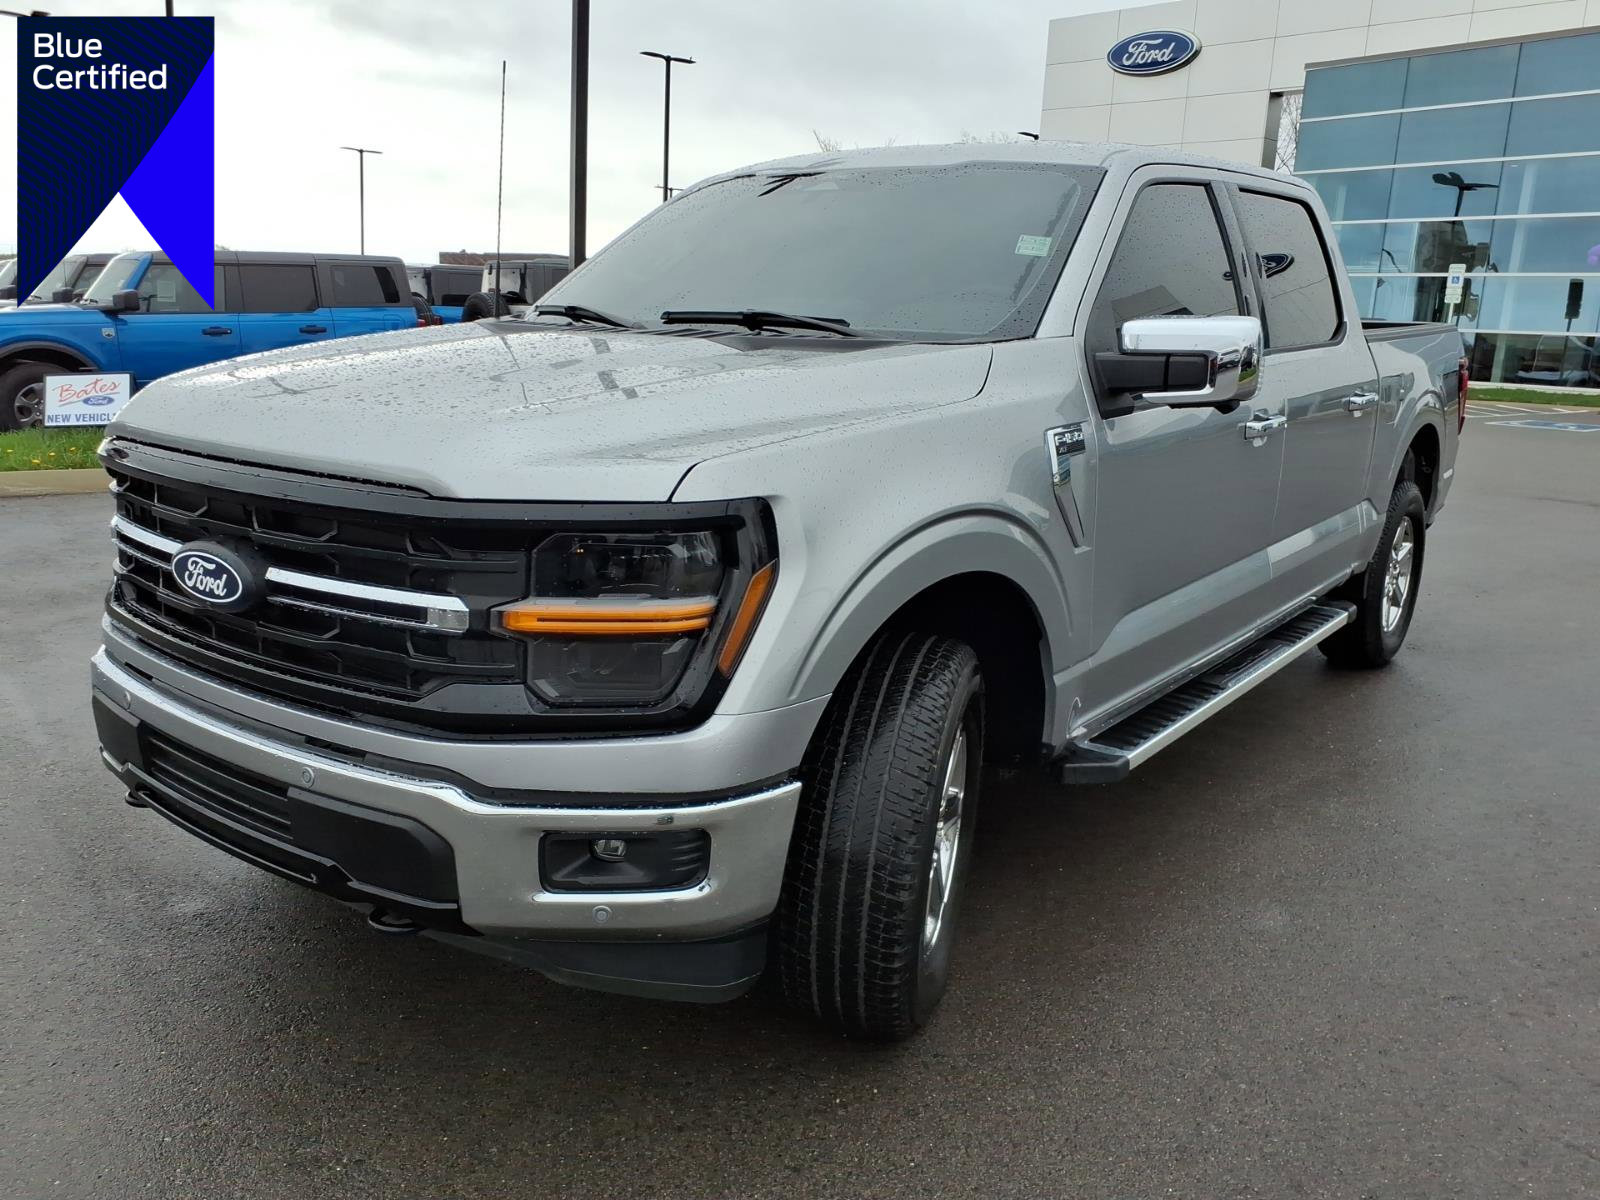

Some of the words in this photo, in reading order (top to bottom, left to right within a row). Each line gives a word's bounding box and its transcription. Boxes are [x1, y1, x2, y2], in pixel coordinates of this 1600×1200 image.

[1122, 38, 1176, 66] Ford
[52, 378, 121, 402] Bates
[47, 414, 71, 424] NEW
[75, 412, 116, 422] VEHICL
[184, 556, 228, 597] Ford
